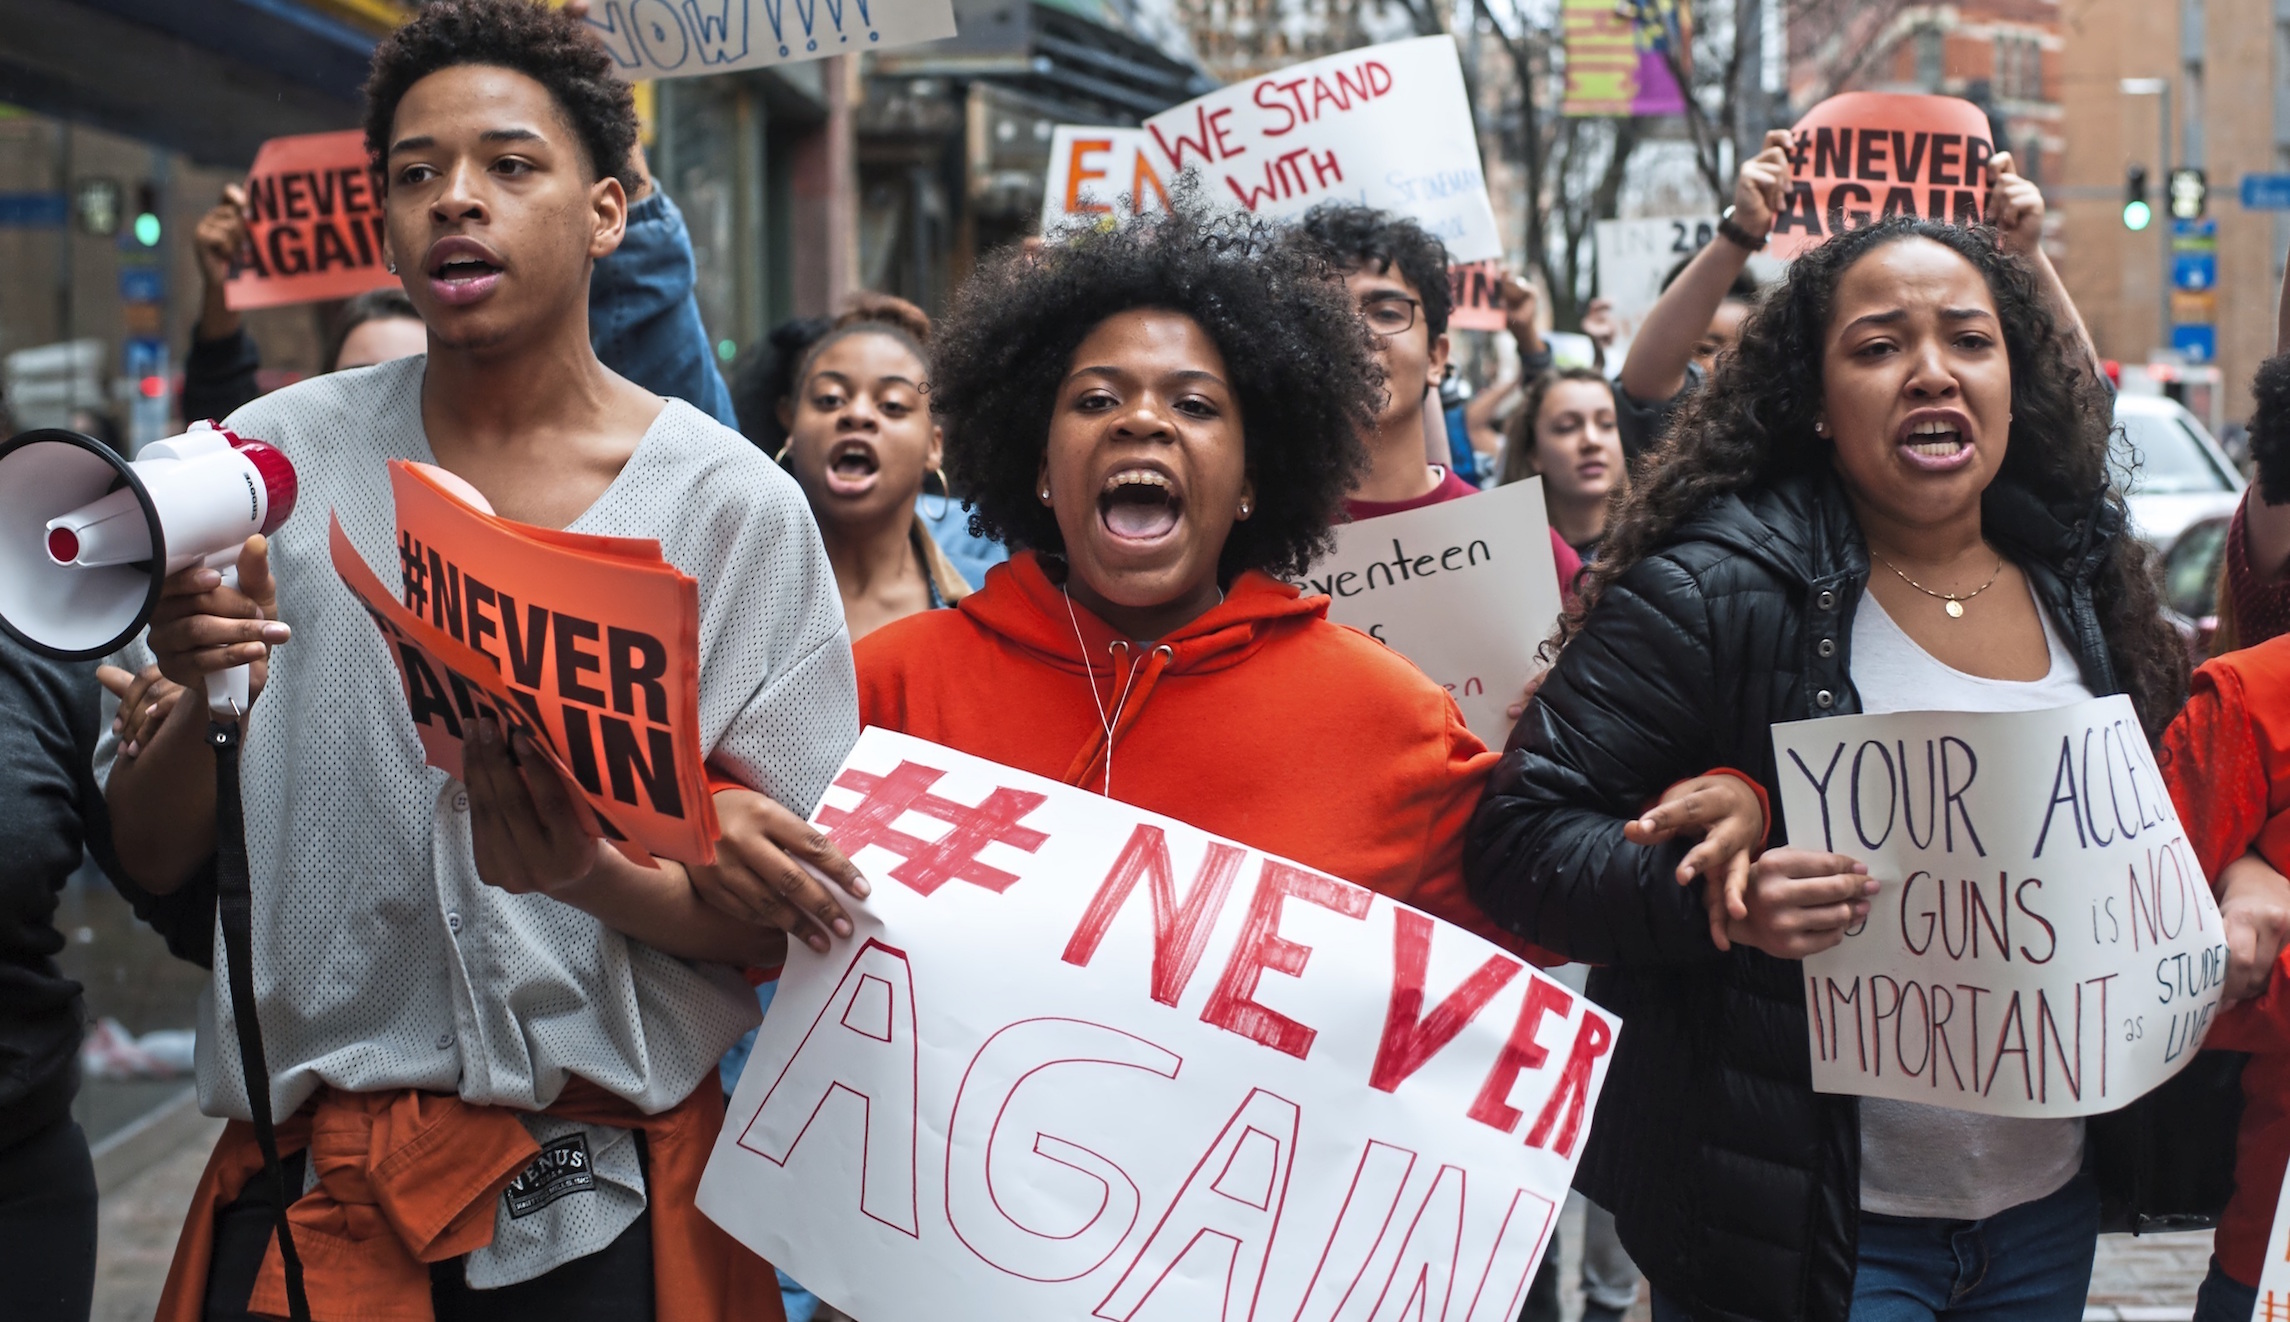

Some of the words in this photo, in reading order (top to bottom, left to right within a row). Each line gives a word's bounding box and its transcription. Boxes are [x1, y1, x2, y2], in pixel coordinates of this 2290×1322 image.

[1148, 104, 1246, 174] WE
[1253, 61, 1392, 137] STAND
[1225, 147, 1343, 212] WITH
[399, 529, 672, 727] #NEVER
[1787, 735, 1987, 858] YOUR
[1900, 870, 2056, 965] GUNS
[2129, 836, 2204, 952] NOT
[1810, 973, 2119, 1104] IMPORTANT
[2123, 1014, 2144, 1042] as
[510, 1148, 584, 1191] VENUS
[735, 936, 1555, 1322] AGAIN
